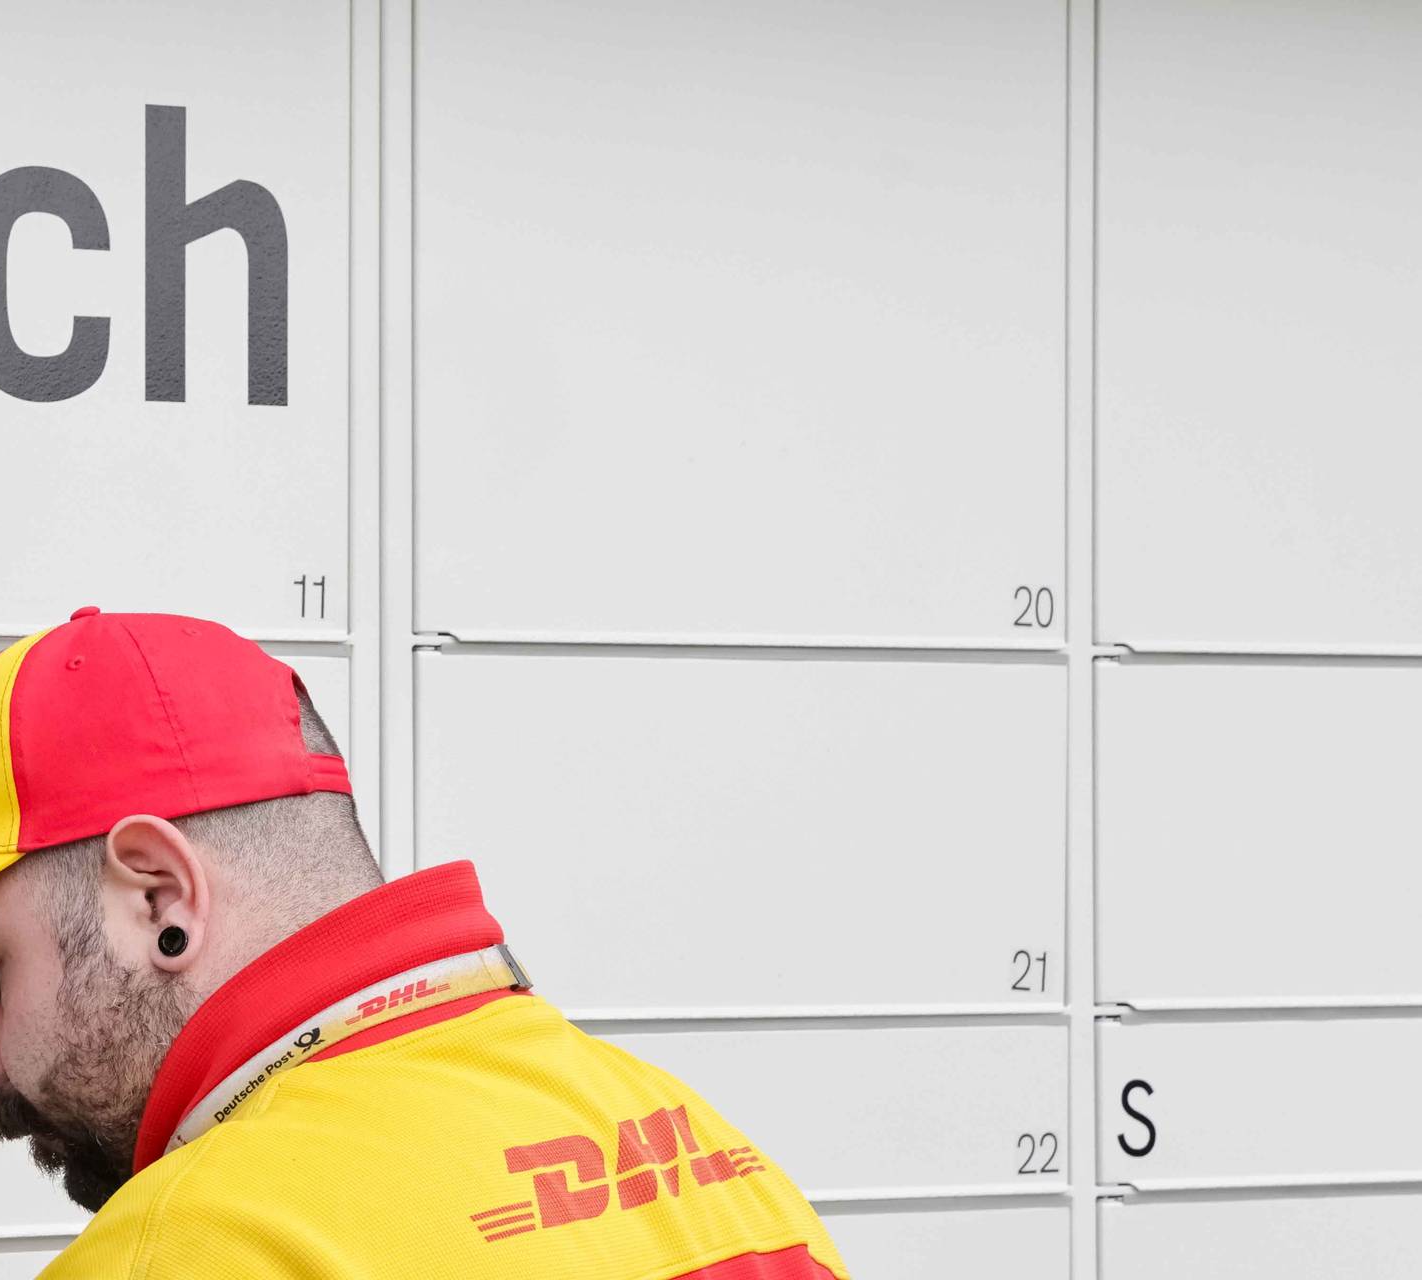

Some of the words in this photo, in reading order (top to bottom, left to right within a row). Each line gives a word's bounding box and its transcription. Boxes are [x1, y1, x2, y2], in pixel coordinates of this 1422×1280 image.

[293, 574, 327, 619] 11
[1013, 585, 1054, 628] 20
[1011, 949, 1048, 992] 21
[354, 978, 441, 1021] DHL
[214, 1073, 265, 1123] Deutsche
[265, 1050, 295, 1075] Post
[1117, 1079, 1157, 1158] S
[502, 1104, 744, 1229] DHL
[1017, 1132, 1060, 1175] 22
